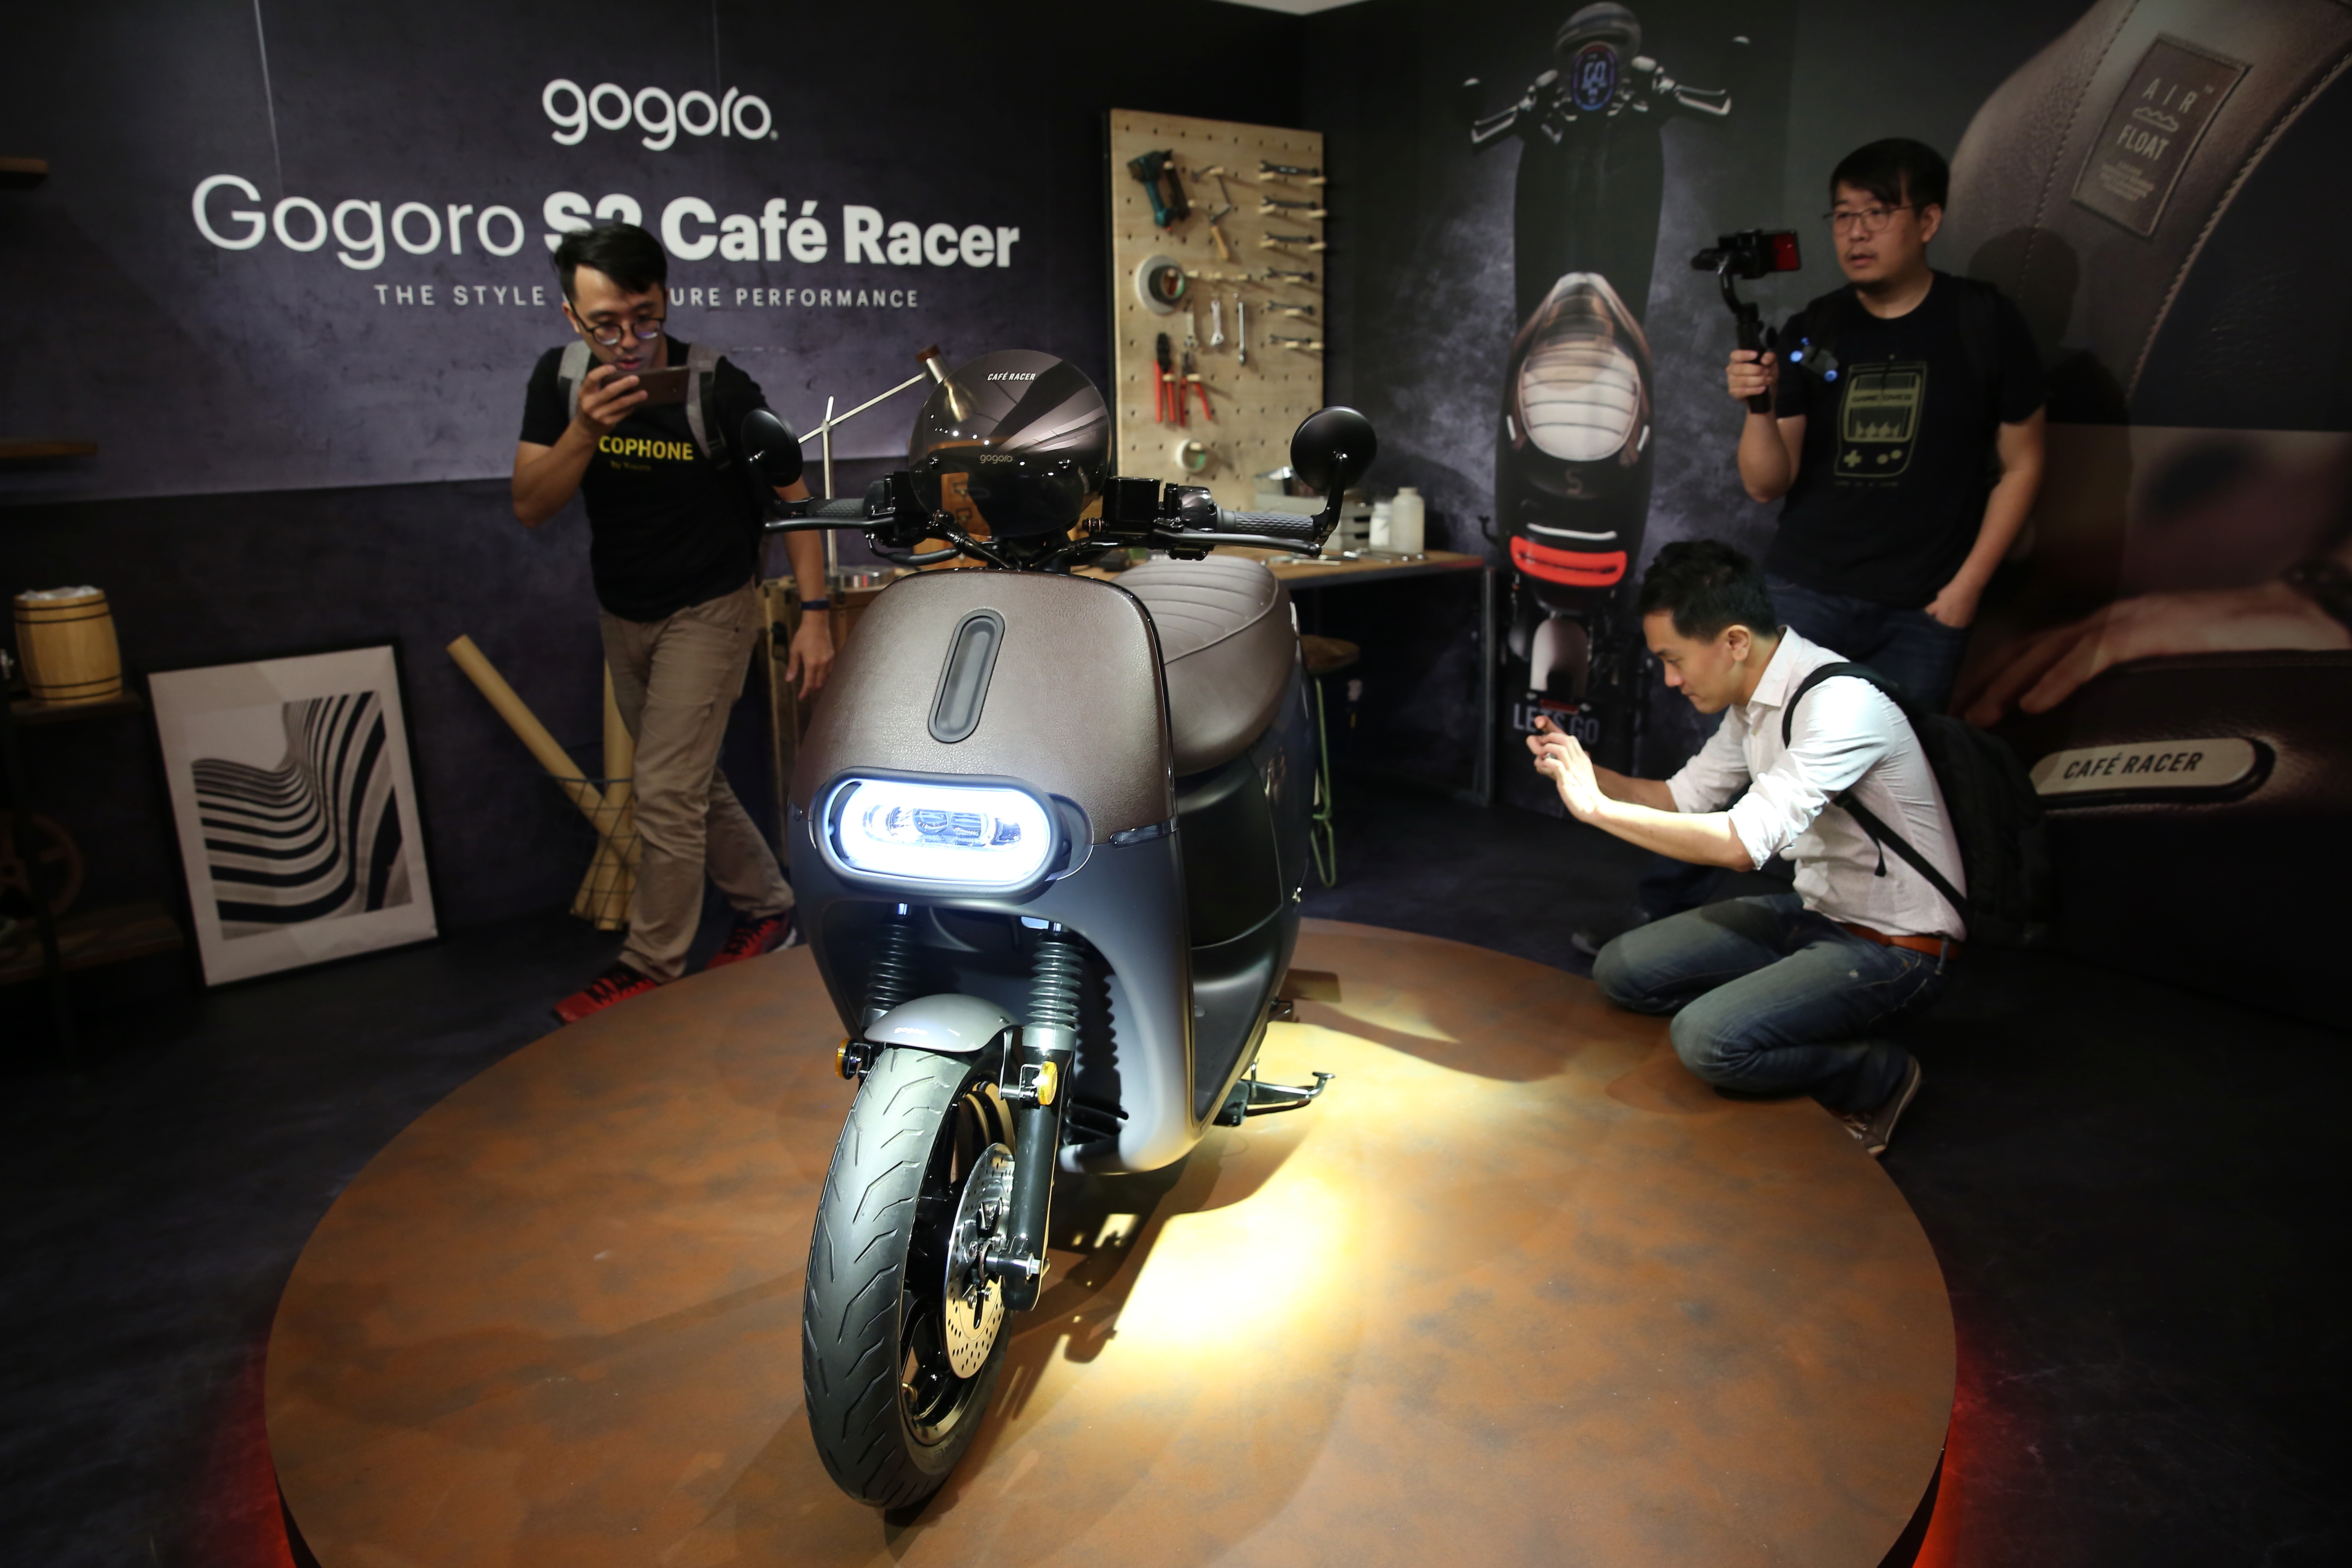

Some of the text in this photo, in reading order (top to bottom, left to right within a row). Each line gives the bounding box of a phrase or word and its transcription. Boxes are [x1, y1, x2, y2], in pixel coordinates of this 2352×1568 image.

[2142, 77, 2198, 114] AIR
[542, 79, 772, 151] gogoro
[2116, 125, 2170, 161] FLOAT
[192, 174, 525, 271] Gogoro
[661, 196, 828, 263] Café
[843, 205, 1019, 267] Racer
[374, 284, 435, 306] THE
[453, 285, 546, 306] STYLE
[670, 287, 721, 306] URE
[736, 288, 917, 307] PERFORMANCE
[987, 371, 1008, 381] CAFÉ
[598, 434, 694, 461] COPHONE
[980, 454, 1013, 464] gogoro
[2063, 751, 2203, 780] CAFÉ RACER
